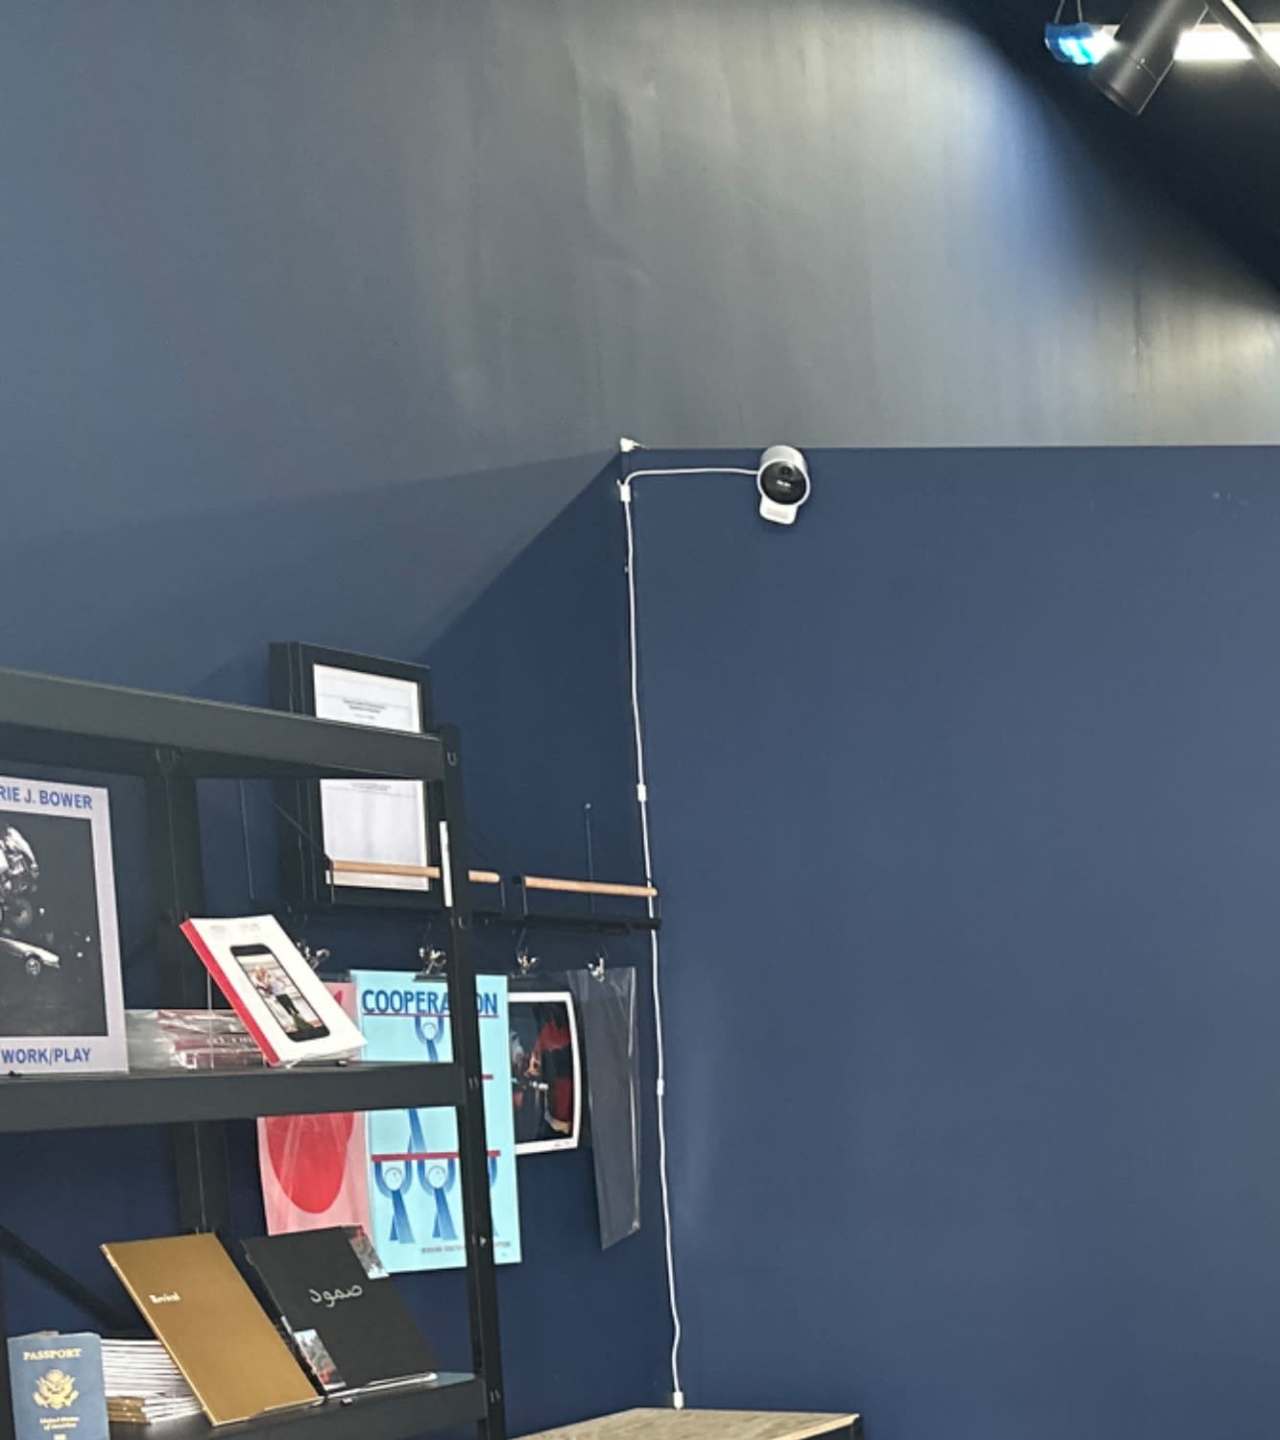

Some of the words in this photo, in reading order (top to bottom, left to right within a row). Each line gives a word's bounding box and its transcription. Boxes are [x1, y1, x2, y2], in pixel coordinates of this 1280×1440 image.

[39, 790, 93, 809] BOWER
[2, 1048, 91, 1066] WORK/PLAY
[23, 1347, 82, 1361] PASSPORT
